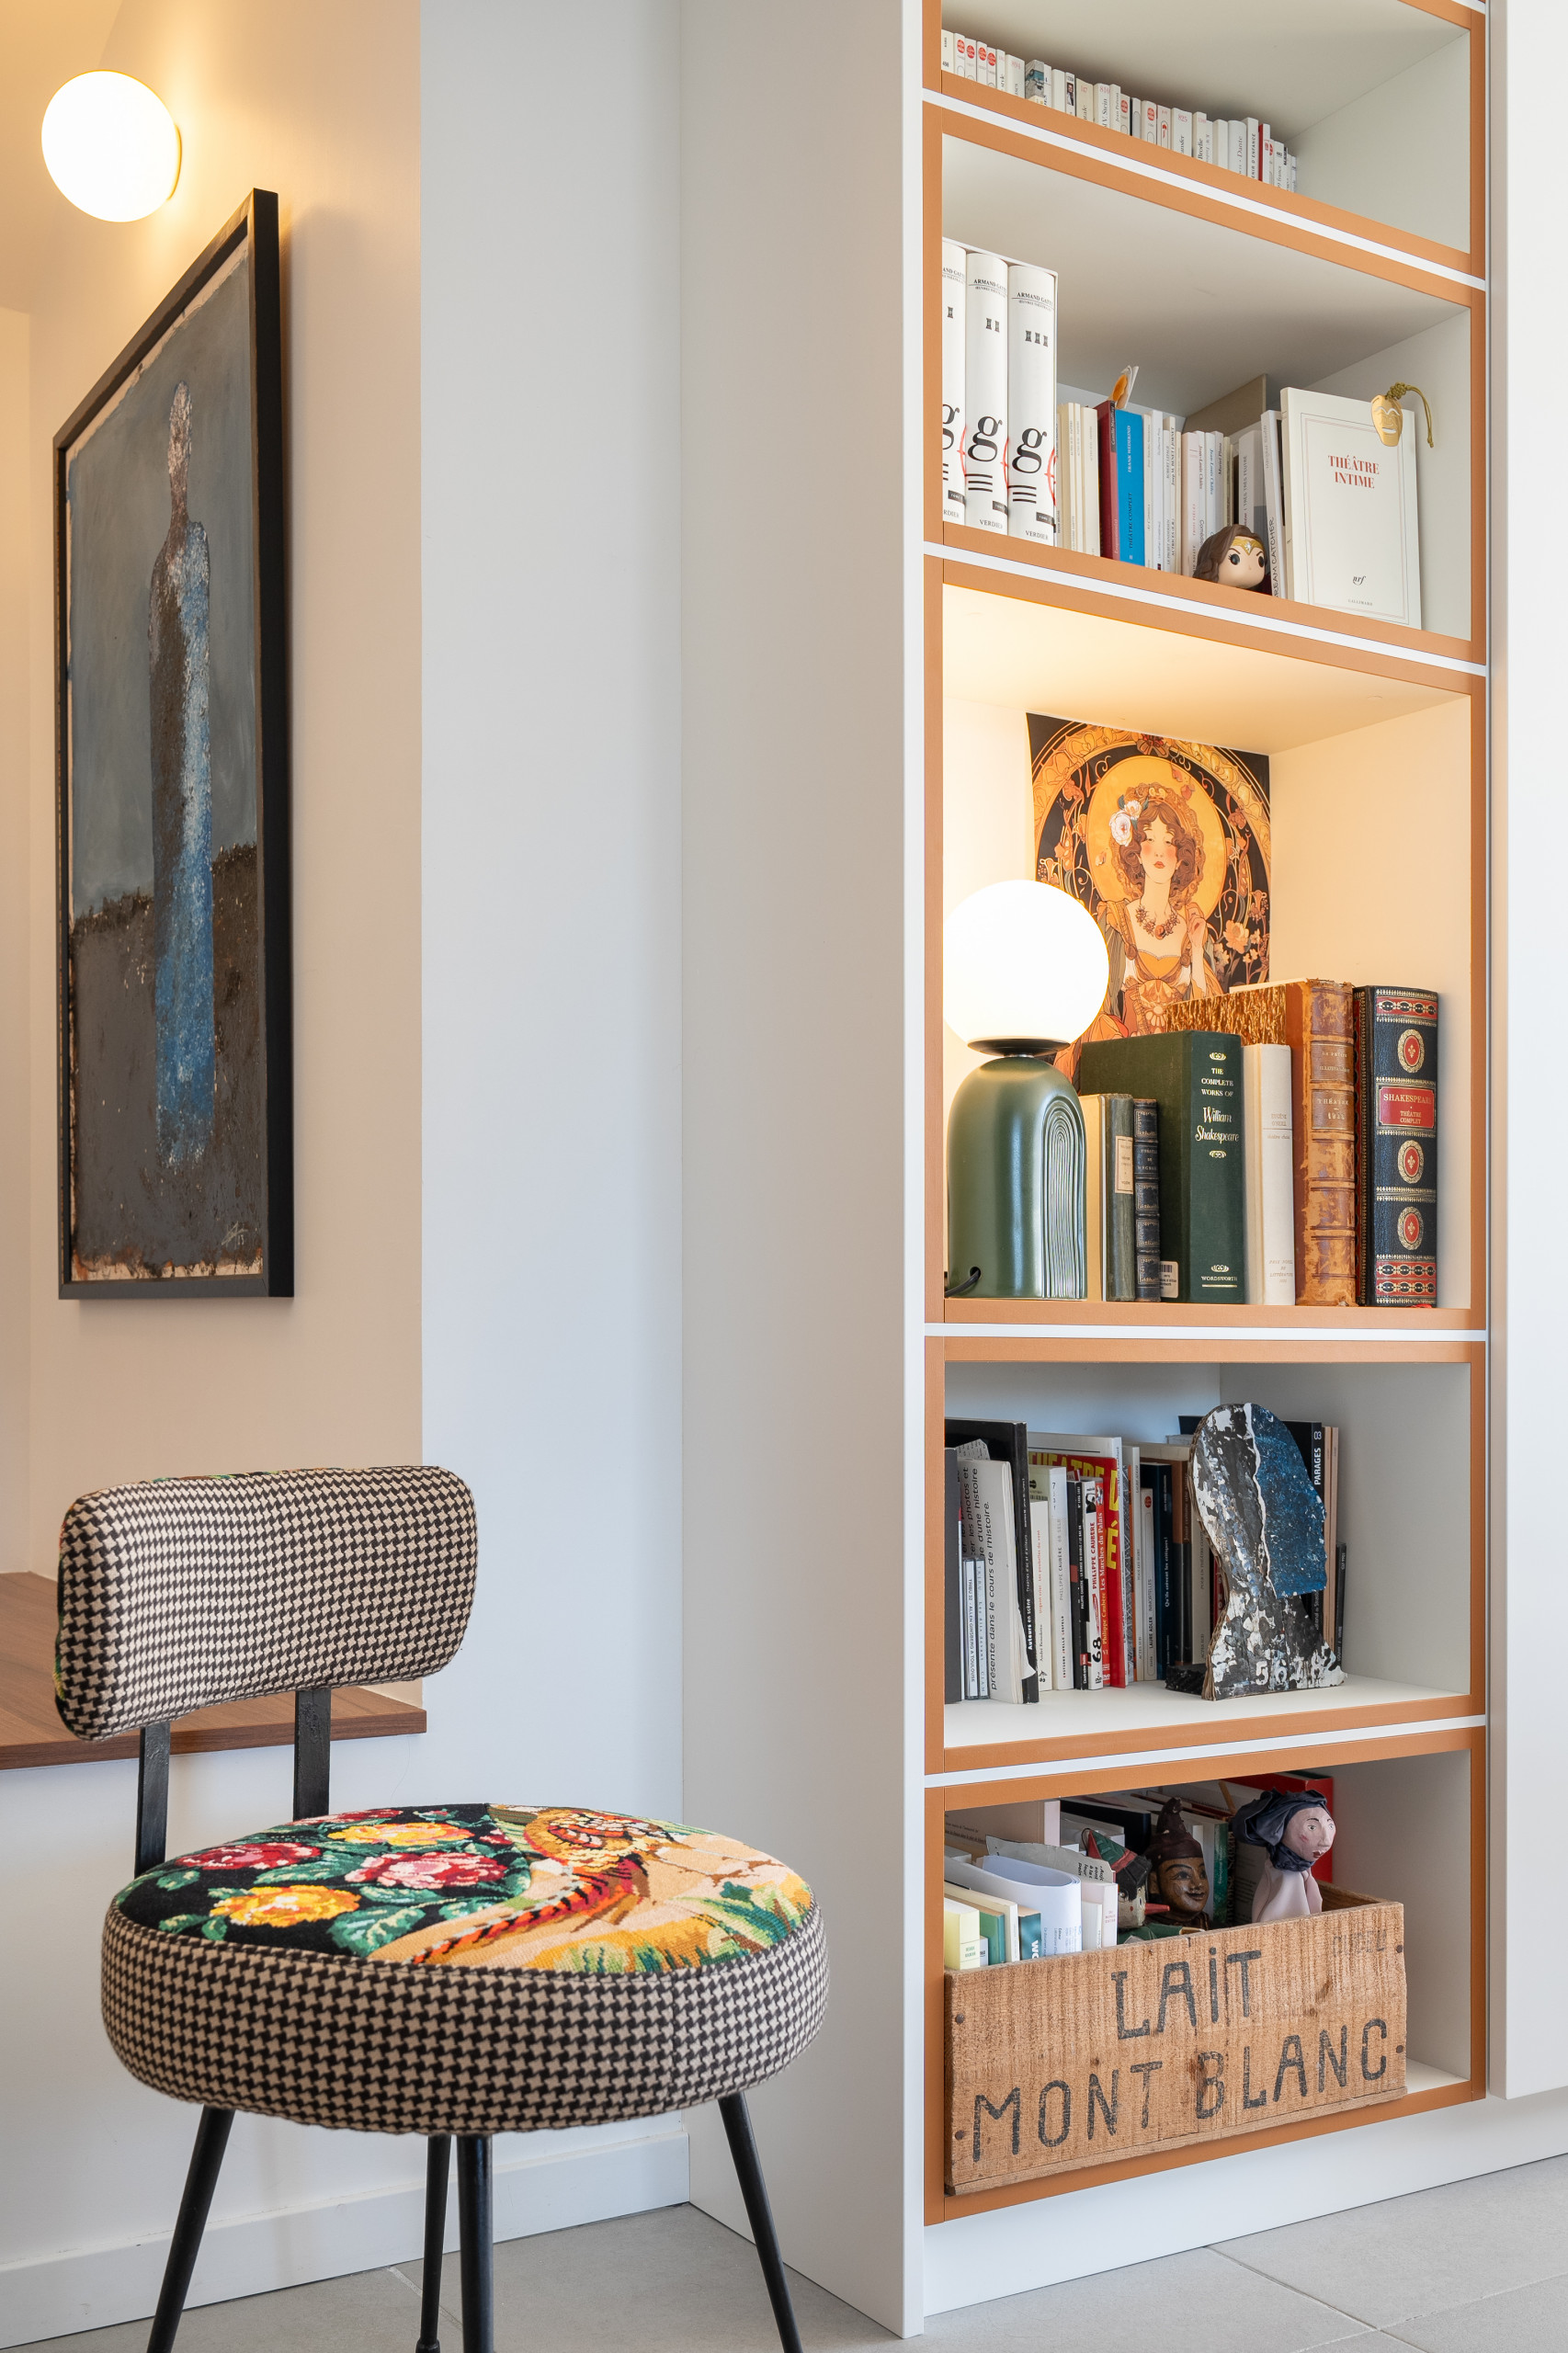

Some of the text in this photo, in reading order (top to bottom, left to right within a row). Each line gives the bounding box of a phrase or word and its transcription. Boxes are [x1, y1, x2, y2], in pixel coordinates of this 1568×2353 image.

[973, 278, 995, 288] ARMAND
[1017, 291, 1052, 306] ARMAND GATTI
[1025, 330, 1049, 347] III
[967, 416, 1003, 462] g
[1011, 428, 1048, 474] g
[1328, 454, 1380, 475] THÉÂTRE
[1335, 472, 1375, 489] INTIME
[943, 509, 960, 517] RDIER
[980, 518, 1003, 529] VERDIER
[1025, 529, 1049, 540] VERDIER
[1268, 517, 1278, 564] CATCHER
[1352, 575, 1367, 586] nrf
[1210, 1067, 1224, 1075] THE
[1200, 1077, 1234, 1086] COMPLETE
[1200, 1088, 1223, 1097] WORKS
[1382, 1094, 1432, 1105] SHAKESPEARE
[1202, 1106, 1233, 1123] William
[1195, 1124, 1240, 1144] Shakespeare
[962, 1467, 970, 1479] et
[1313, 1447, 1322, 1485] PARAGES
[963, 1483, 973, 1521] photos
[971, 1468, 983, 1542] d'une histoire
[983, 1501, 994, 1549] l'histoire.
[987, 1551, 994, 1565] de
[988, 1602, 994, 1611] le
[1092, 1637, 1102, 1663] 68
[989, 1643, 997, 1690] présente
[1256, 1660, 1268, 1686] 5
[972, 2018, 1388, 2163] MONT BLANC
